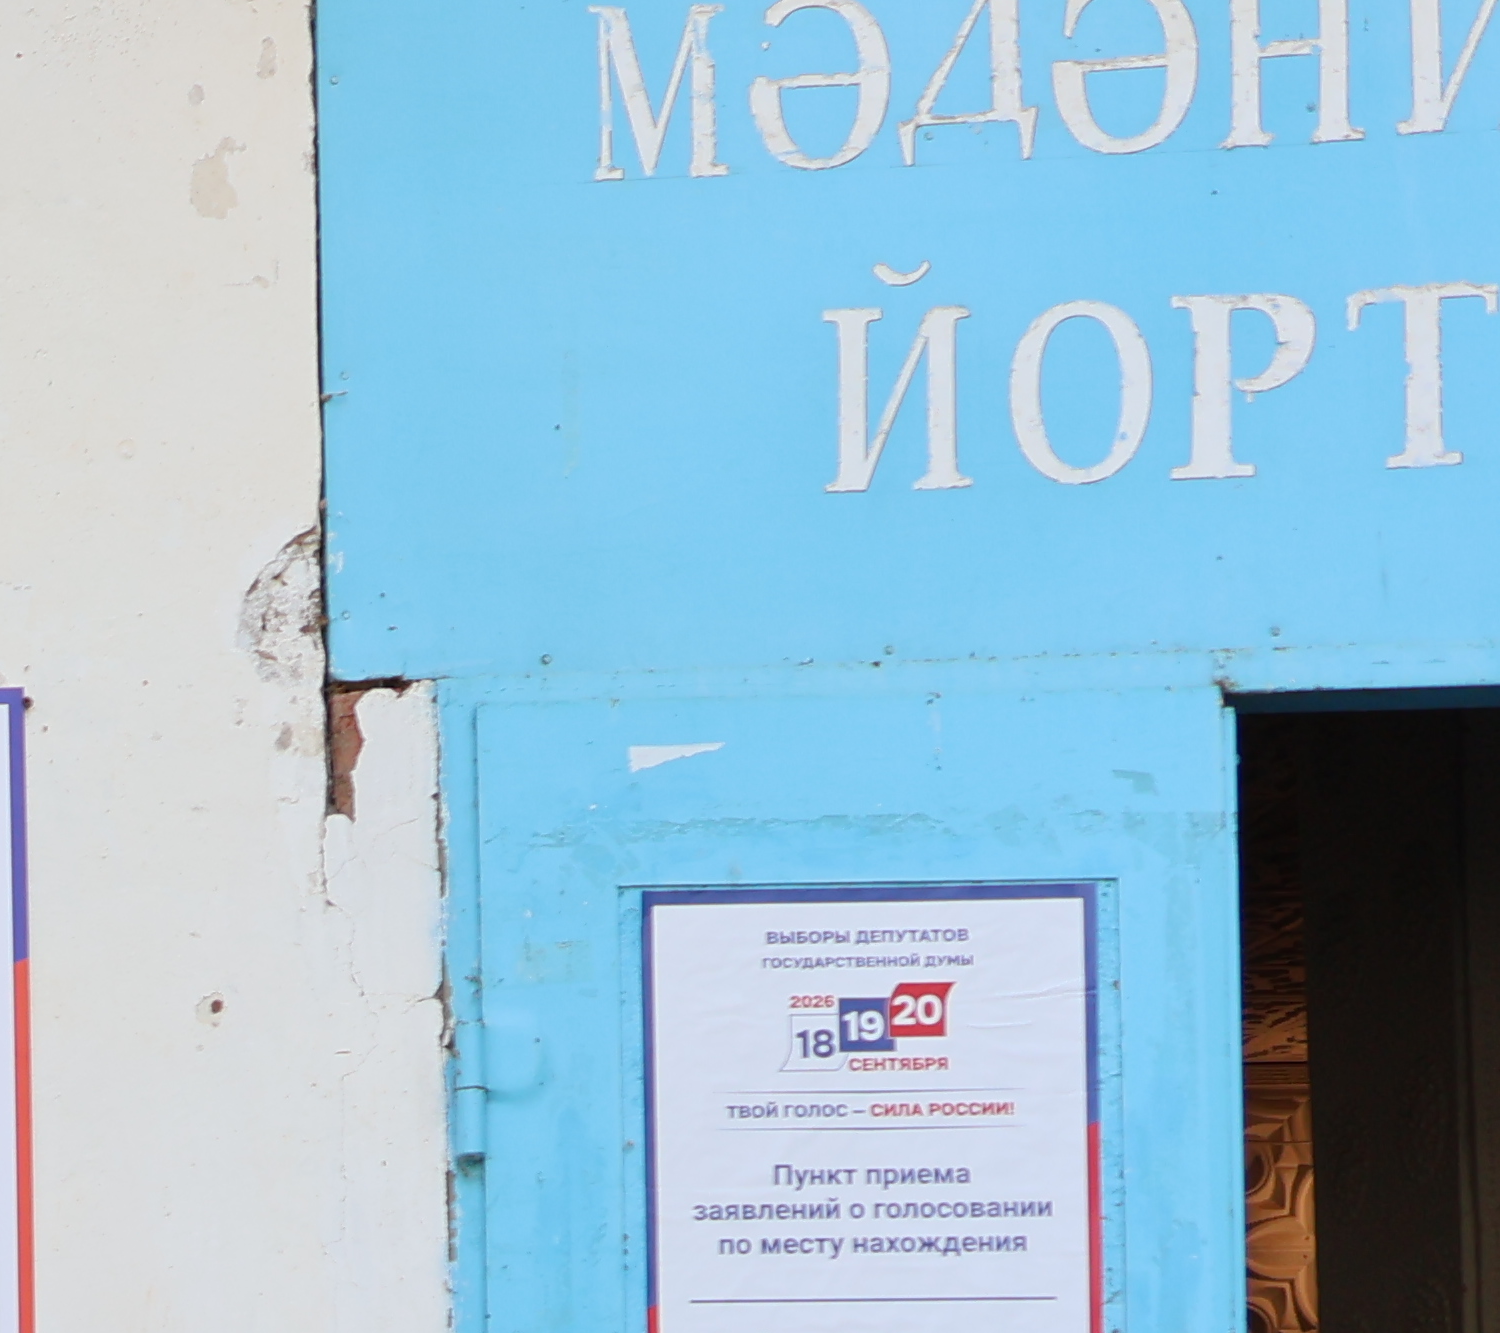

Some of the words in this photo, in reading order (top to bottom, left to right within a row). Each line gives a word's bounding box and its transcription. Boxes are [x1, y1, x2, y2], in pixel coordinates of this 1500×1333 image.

[823, 259, 1500, 494] ЙОРТ
[765, 930, 851, 946] ВЫБОРЫ
[855, 928, 970, 945] ДЕПУТАТОВ
[761, 953, 921, 970] ГОСУДАРСТВЕННОЙ
[924, 953, 975, 969] ДУМЫ
[789, 995, 835, 1009] 2026
[795, 1029, 836, 1058] 18
[843, 1010, 885, 1042] 19
[891, 994, 944, 1025] 20
[848, 1056, 949, 1072] СЕНТЯБРЯ
[725, 1100, 779, 1119] ТВОЙ
[783, 1103, 848, 1119] ГОЛОС
[870, 1102, 924, 1117] СИЛА
[929, 1101, 1015, 1116] РОССИИ!
[772, 1164, 858, 1190] Пункт
[866, 1166, 971, 1189] приема
[693, 1197, 842, 1220] заявлений
[850, 1203, 867, 1219] о
[874, 1201, 1053, 1219] голосовании
[719, 1237, 753, 1255] по
[761, 1236, 845, 1259] месту
[853, 1233, 1027, 1256] нахождения
